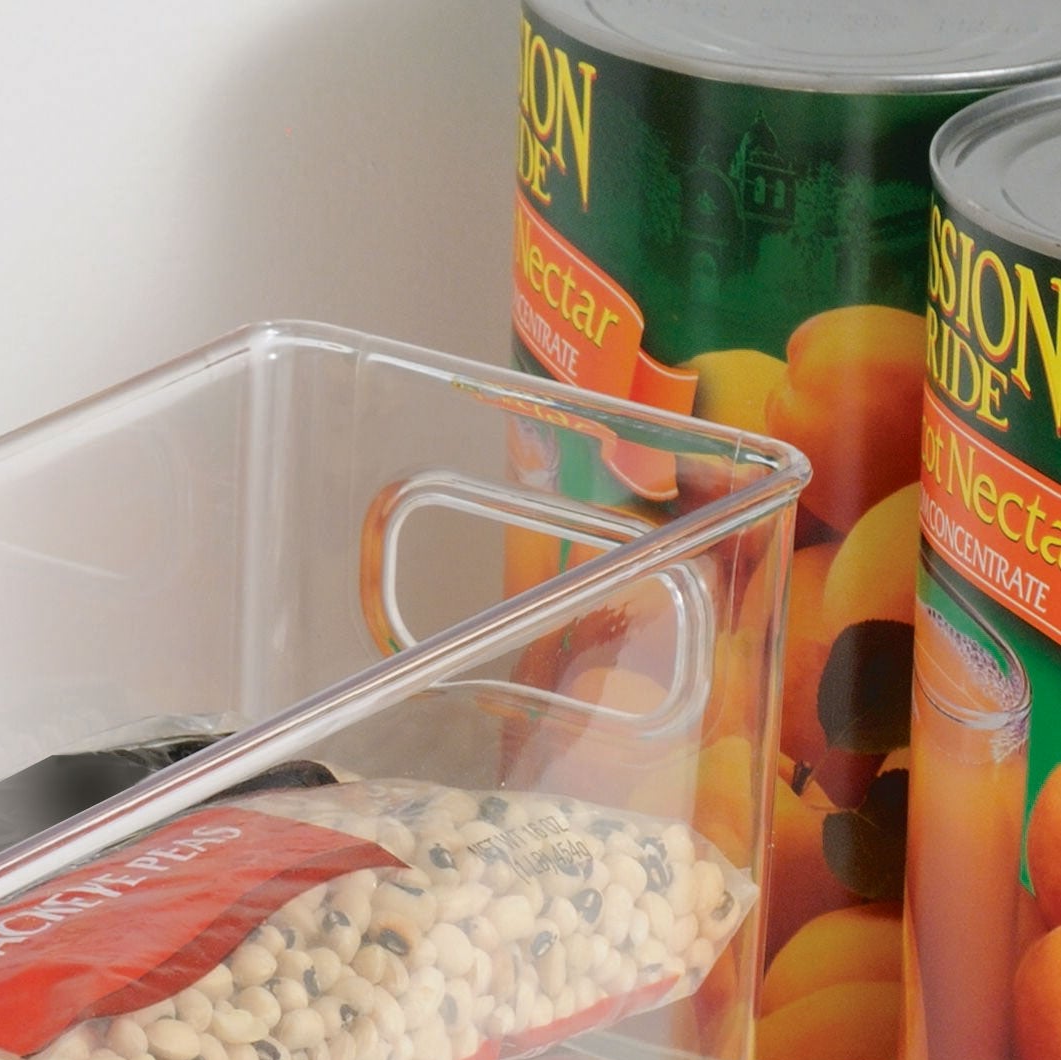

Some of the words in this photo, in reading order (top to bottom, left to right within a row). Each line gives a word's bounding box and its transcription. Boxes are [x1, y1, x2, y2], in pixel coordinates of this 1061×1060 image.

[515, 206, 620, 348] Nectar
[929, 499, 1050, 614] CONCENTRATE
[946, 432, 1061, 571] Necta
[127, 825, 241, 872] PEAS
